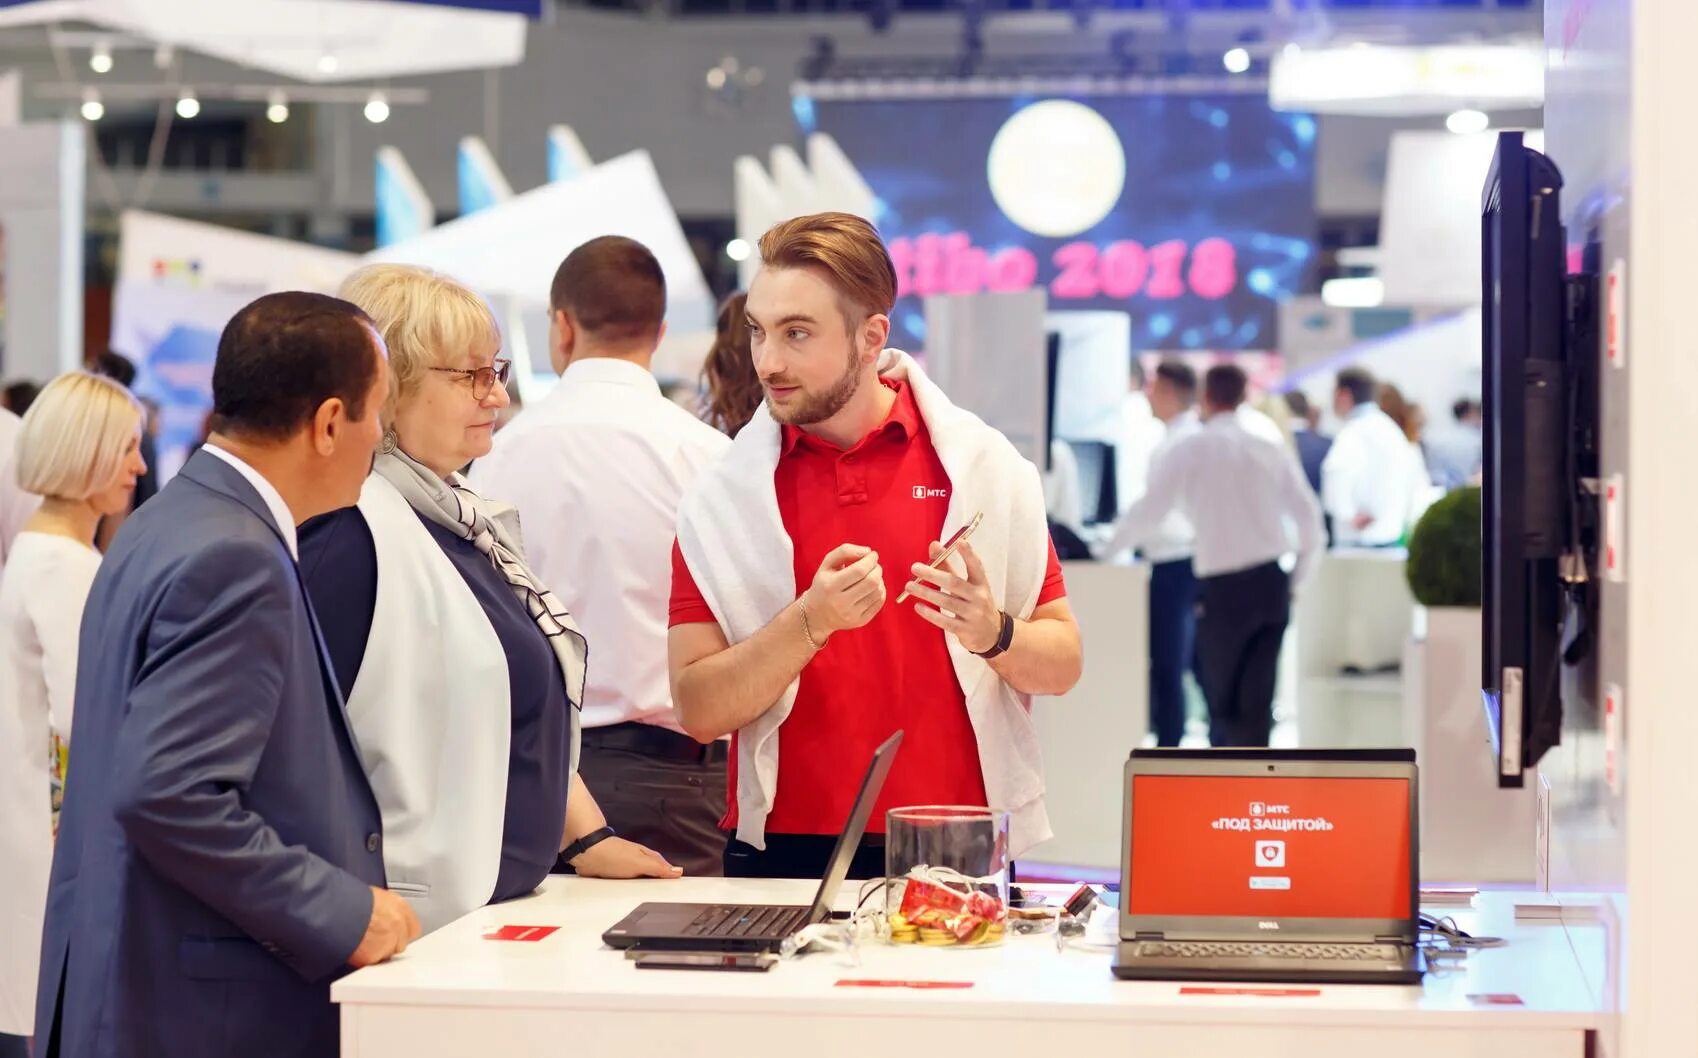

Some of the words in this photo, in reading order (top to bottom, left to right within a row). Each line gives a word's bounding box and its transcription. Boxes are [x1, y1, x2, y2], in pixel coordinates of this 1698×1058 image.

[1050, 238, 1236, 299] 2018
[926, 489, 947, 497] МТС
[1266, 805, 1290, 814] МТС
[1211, 817, 1251, 832] «ПОД
[1253, 817, 1334, 832] ЗАЩИТОЙ»
[1258, 921, 1280, 929] DELL
